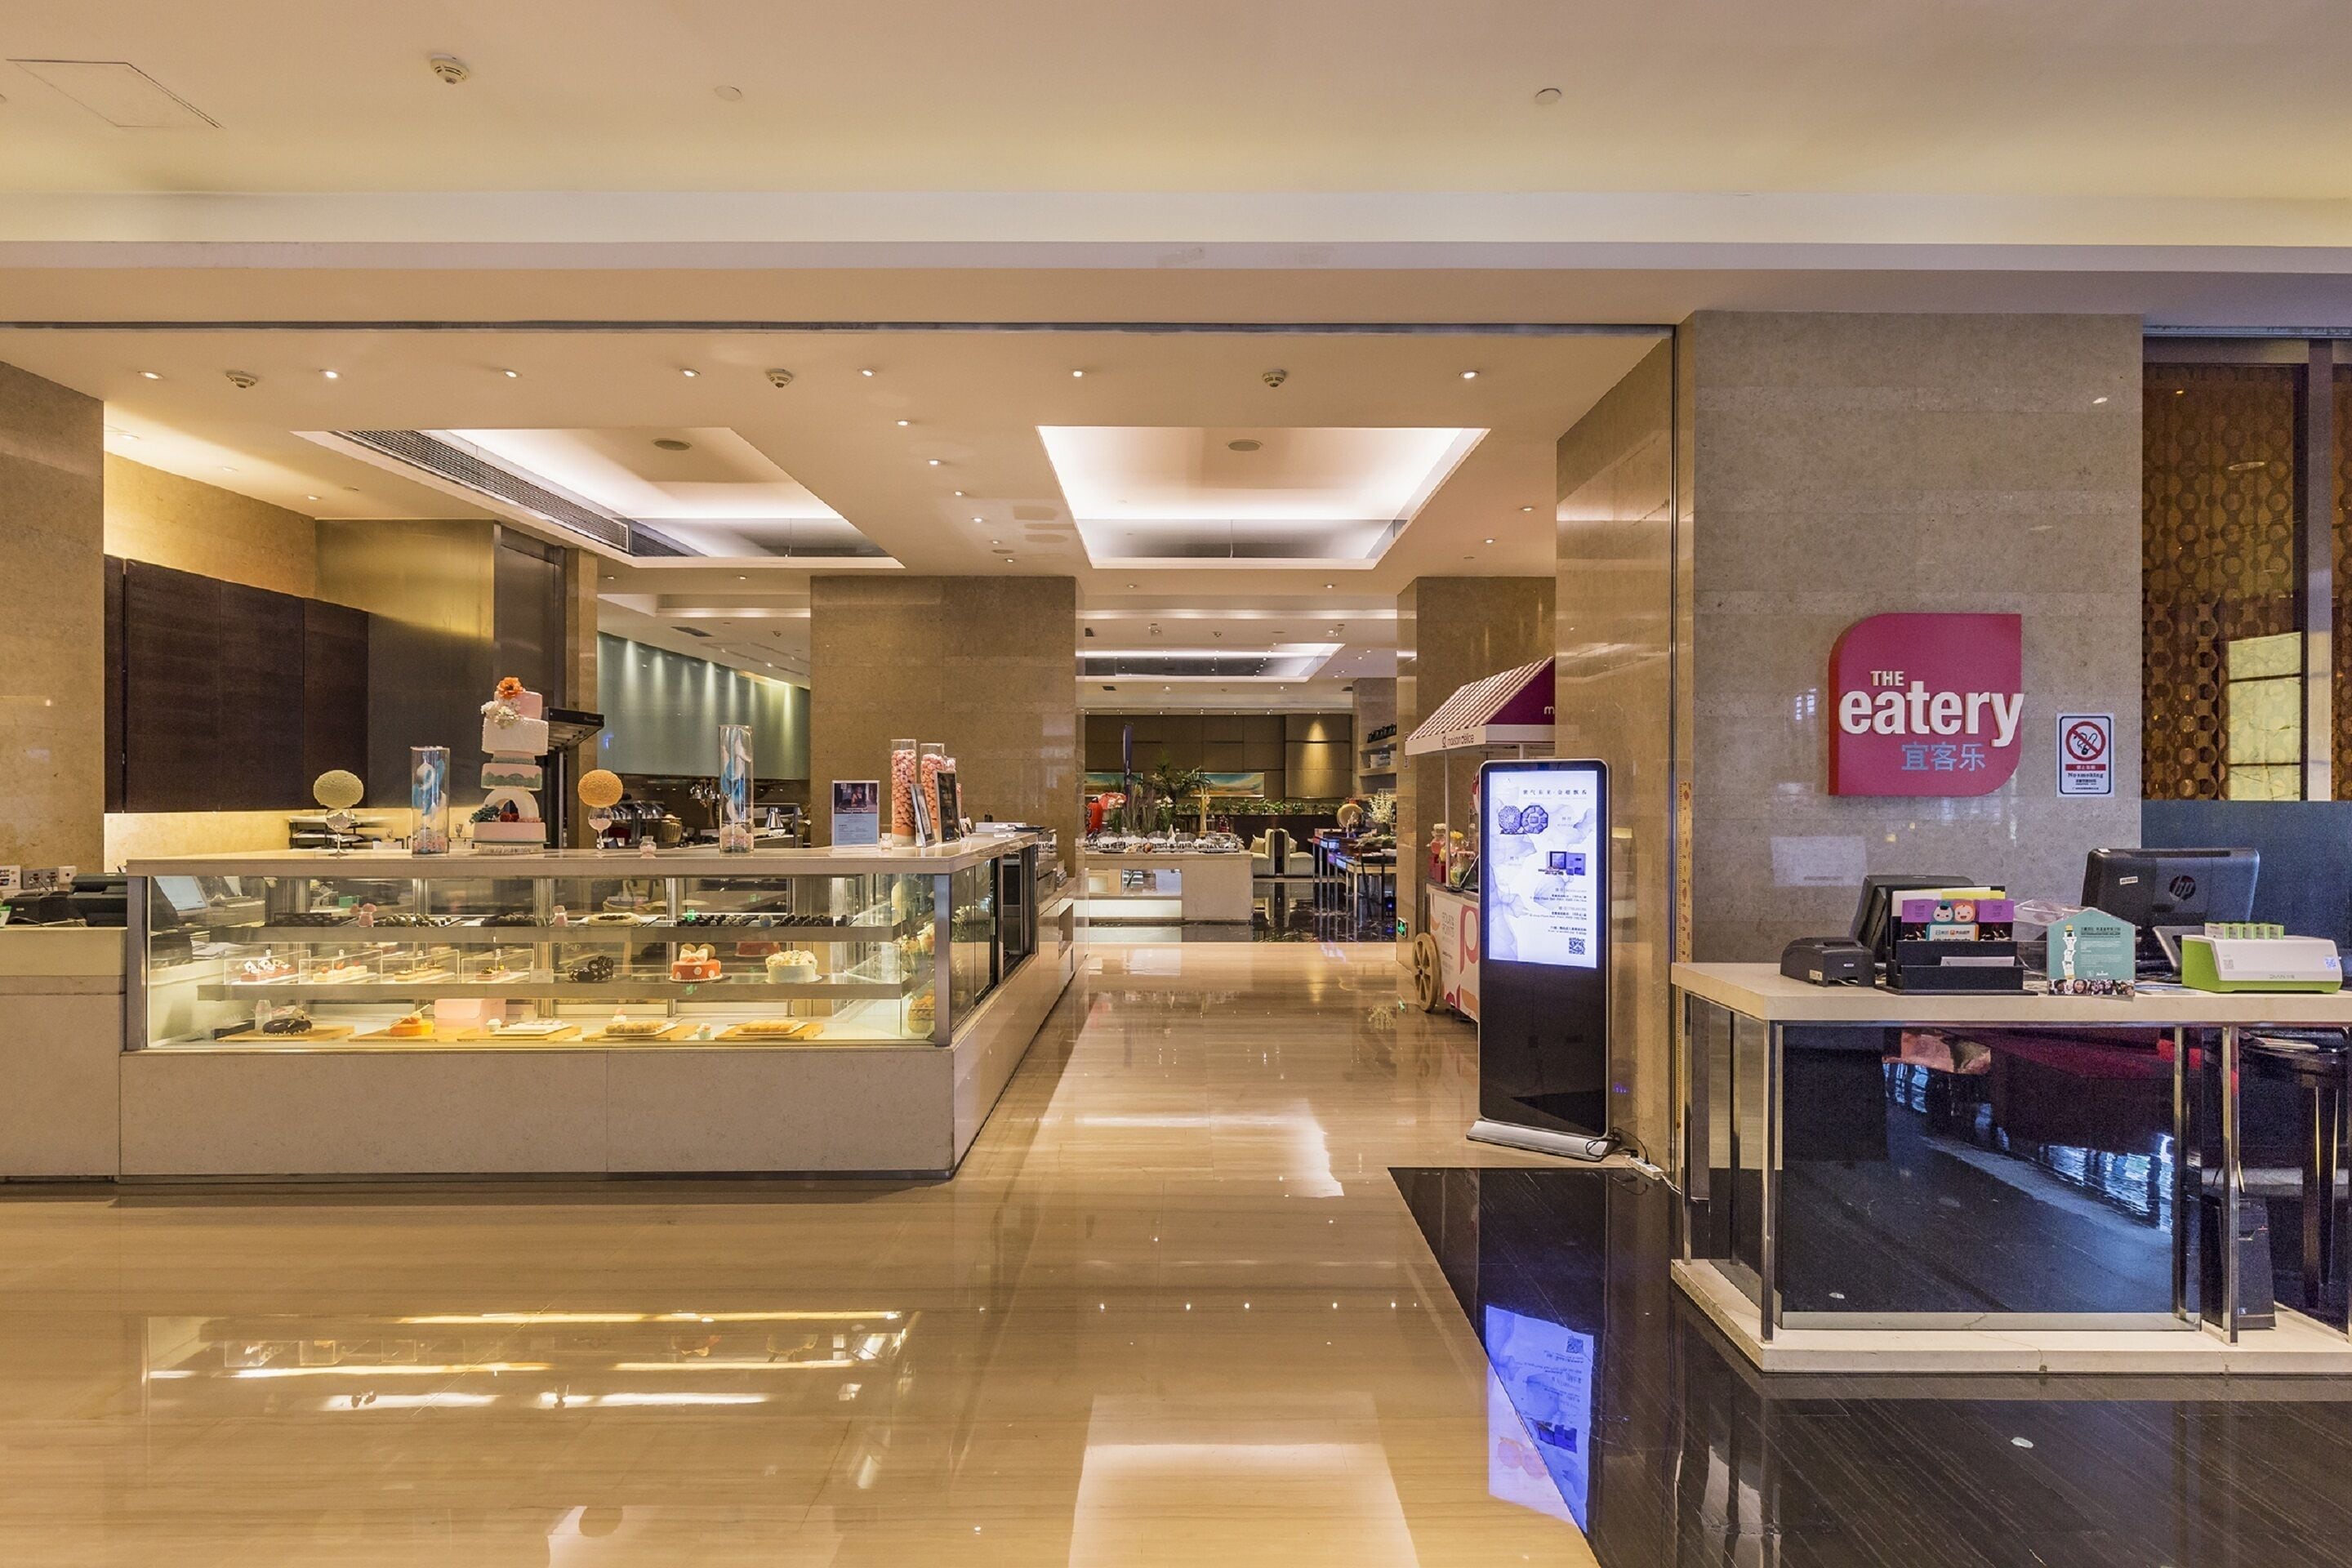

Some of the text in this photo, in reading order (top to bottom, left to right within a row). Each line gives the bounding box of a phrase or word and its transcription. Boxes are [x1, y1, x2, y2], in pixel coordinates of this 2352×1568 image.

[1870, 670, 1904, 686] THE
[1838, 680, 2025, 747] eatery
[1901, 742, 1986, 772] 宜客乐
